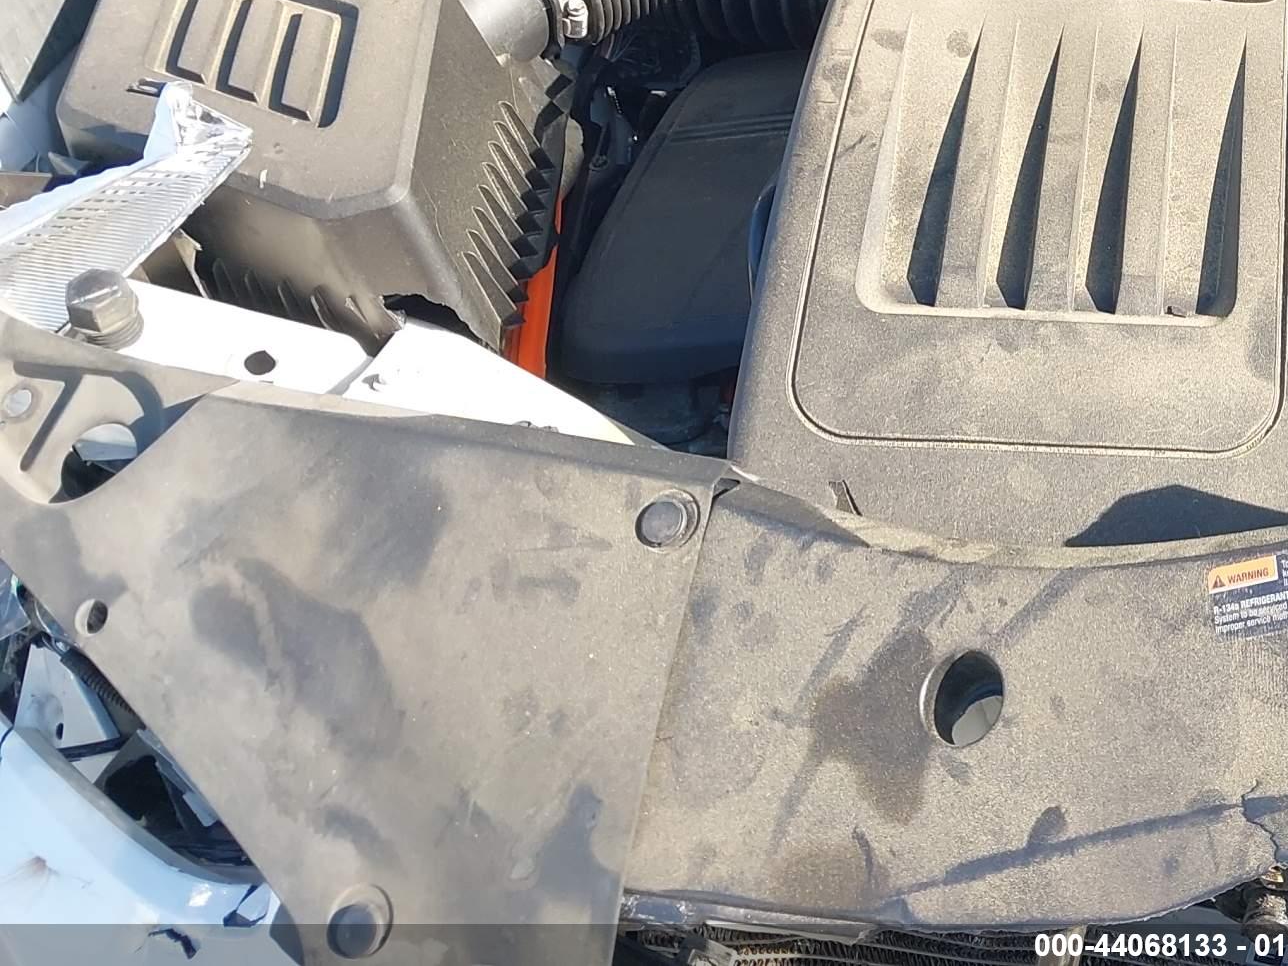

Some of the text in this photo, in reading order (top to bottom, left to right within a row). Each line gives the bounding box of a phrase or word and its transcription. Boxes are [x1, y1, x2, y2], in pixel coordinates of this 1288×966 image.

[1228, 568, 1269, 584] WARNING
[1213, 603, 1239, 615] R-134a
[1214, 611, 1239, 625] System
[1241, 610, 1248, 619] to
[1249, 608, 1258, 618] be
[1258, 601, 1288, 617] serviced
[1215, 621, 1246, 634] Improper
[1247, 616, 1272, 627] service
